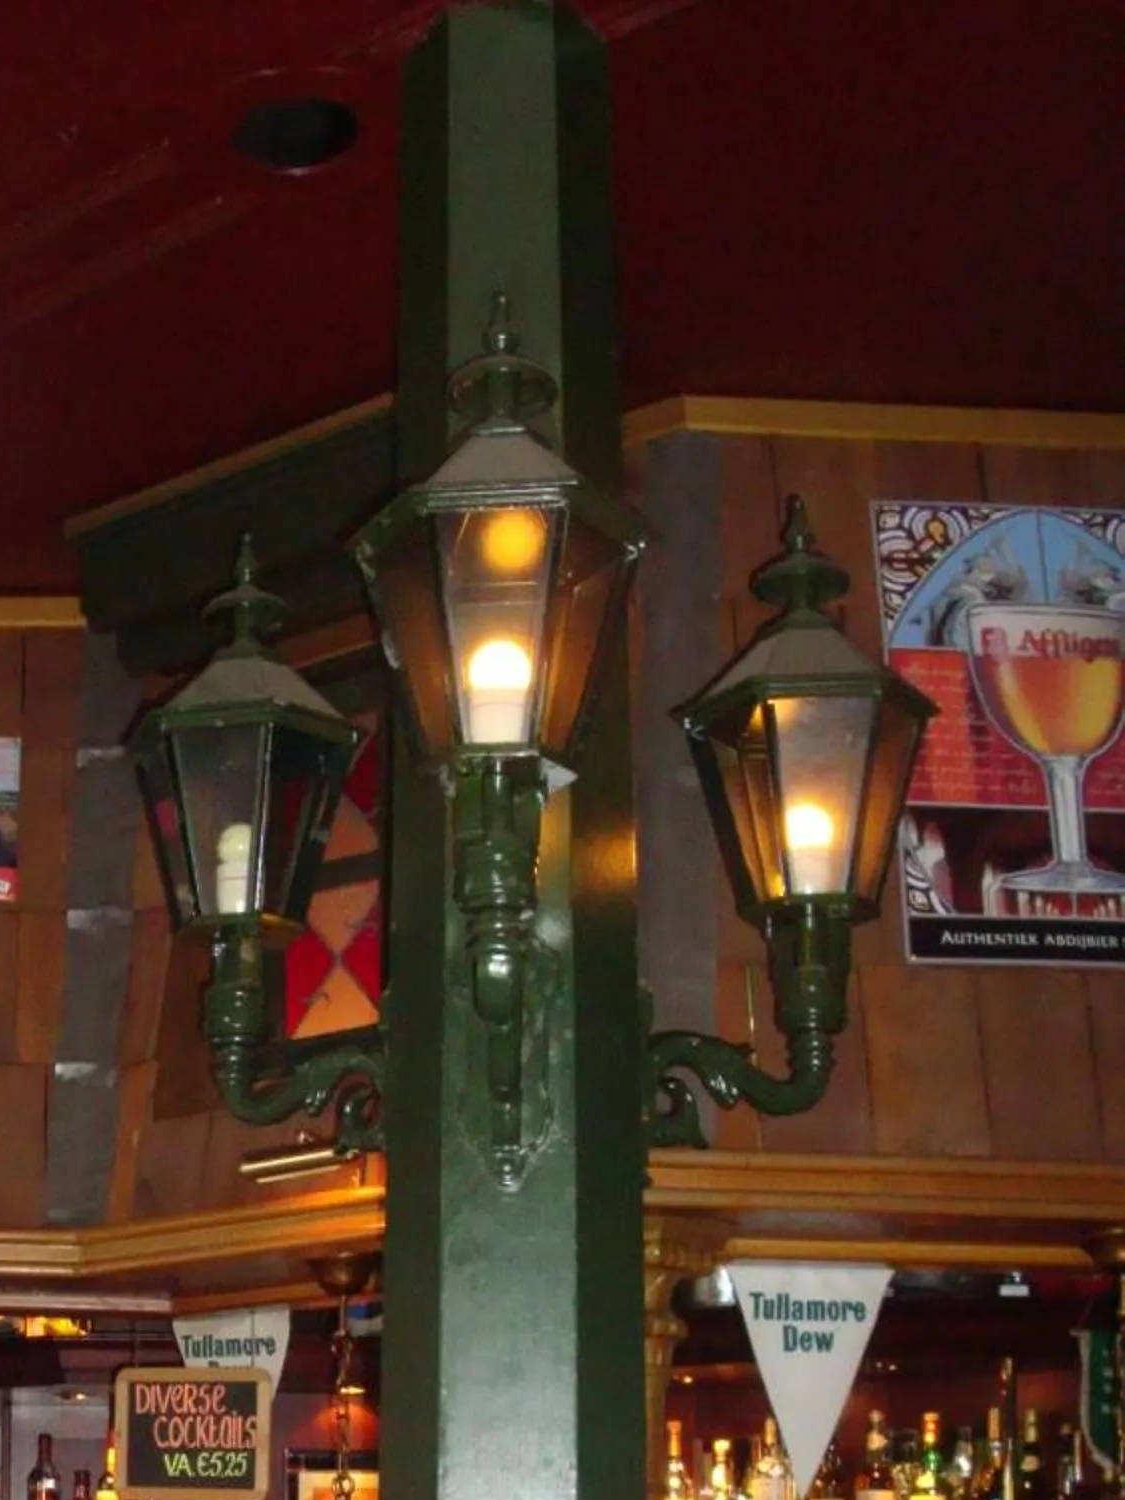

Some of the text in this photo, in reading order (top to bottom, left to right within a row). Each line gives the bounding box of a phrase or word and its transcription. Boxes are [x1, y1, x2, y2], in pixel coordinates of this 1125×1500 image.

[749, 1292, 867, 1322] Tullamore
[181, 1334, 277, 1359] Tullamore
[783, 1325, 835, 1353] Dew
